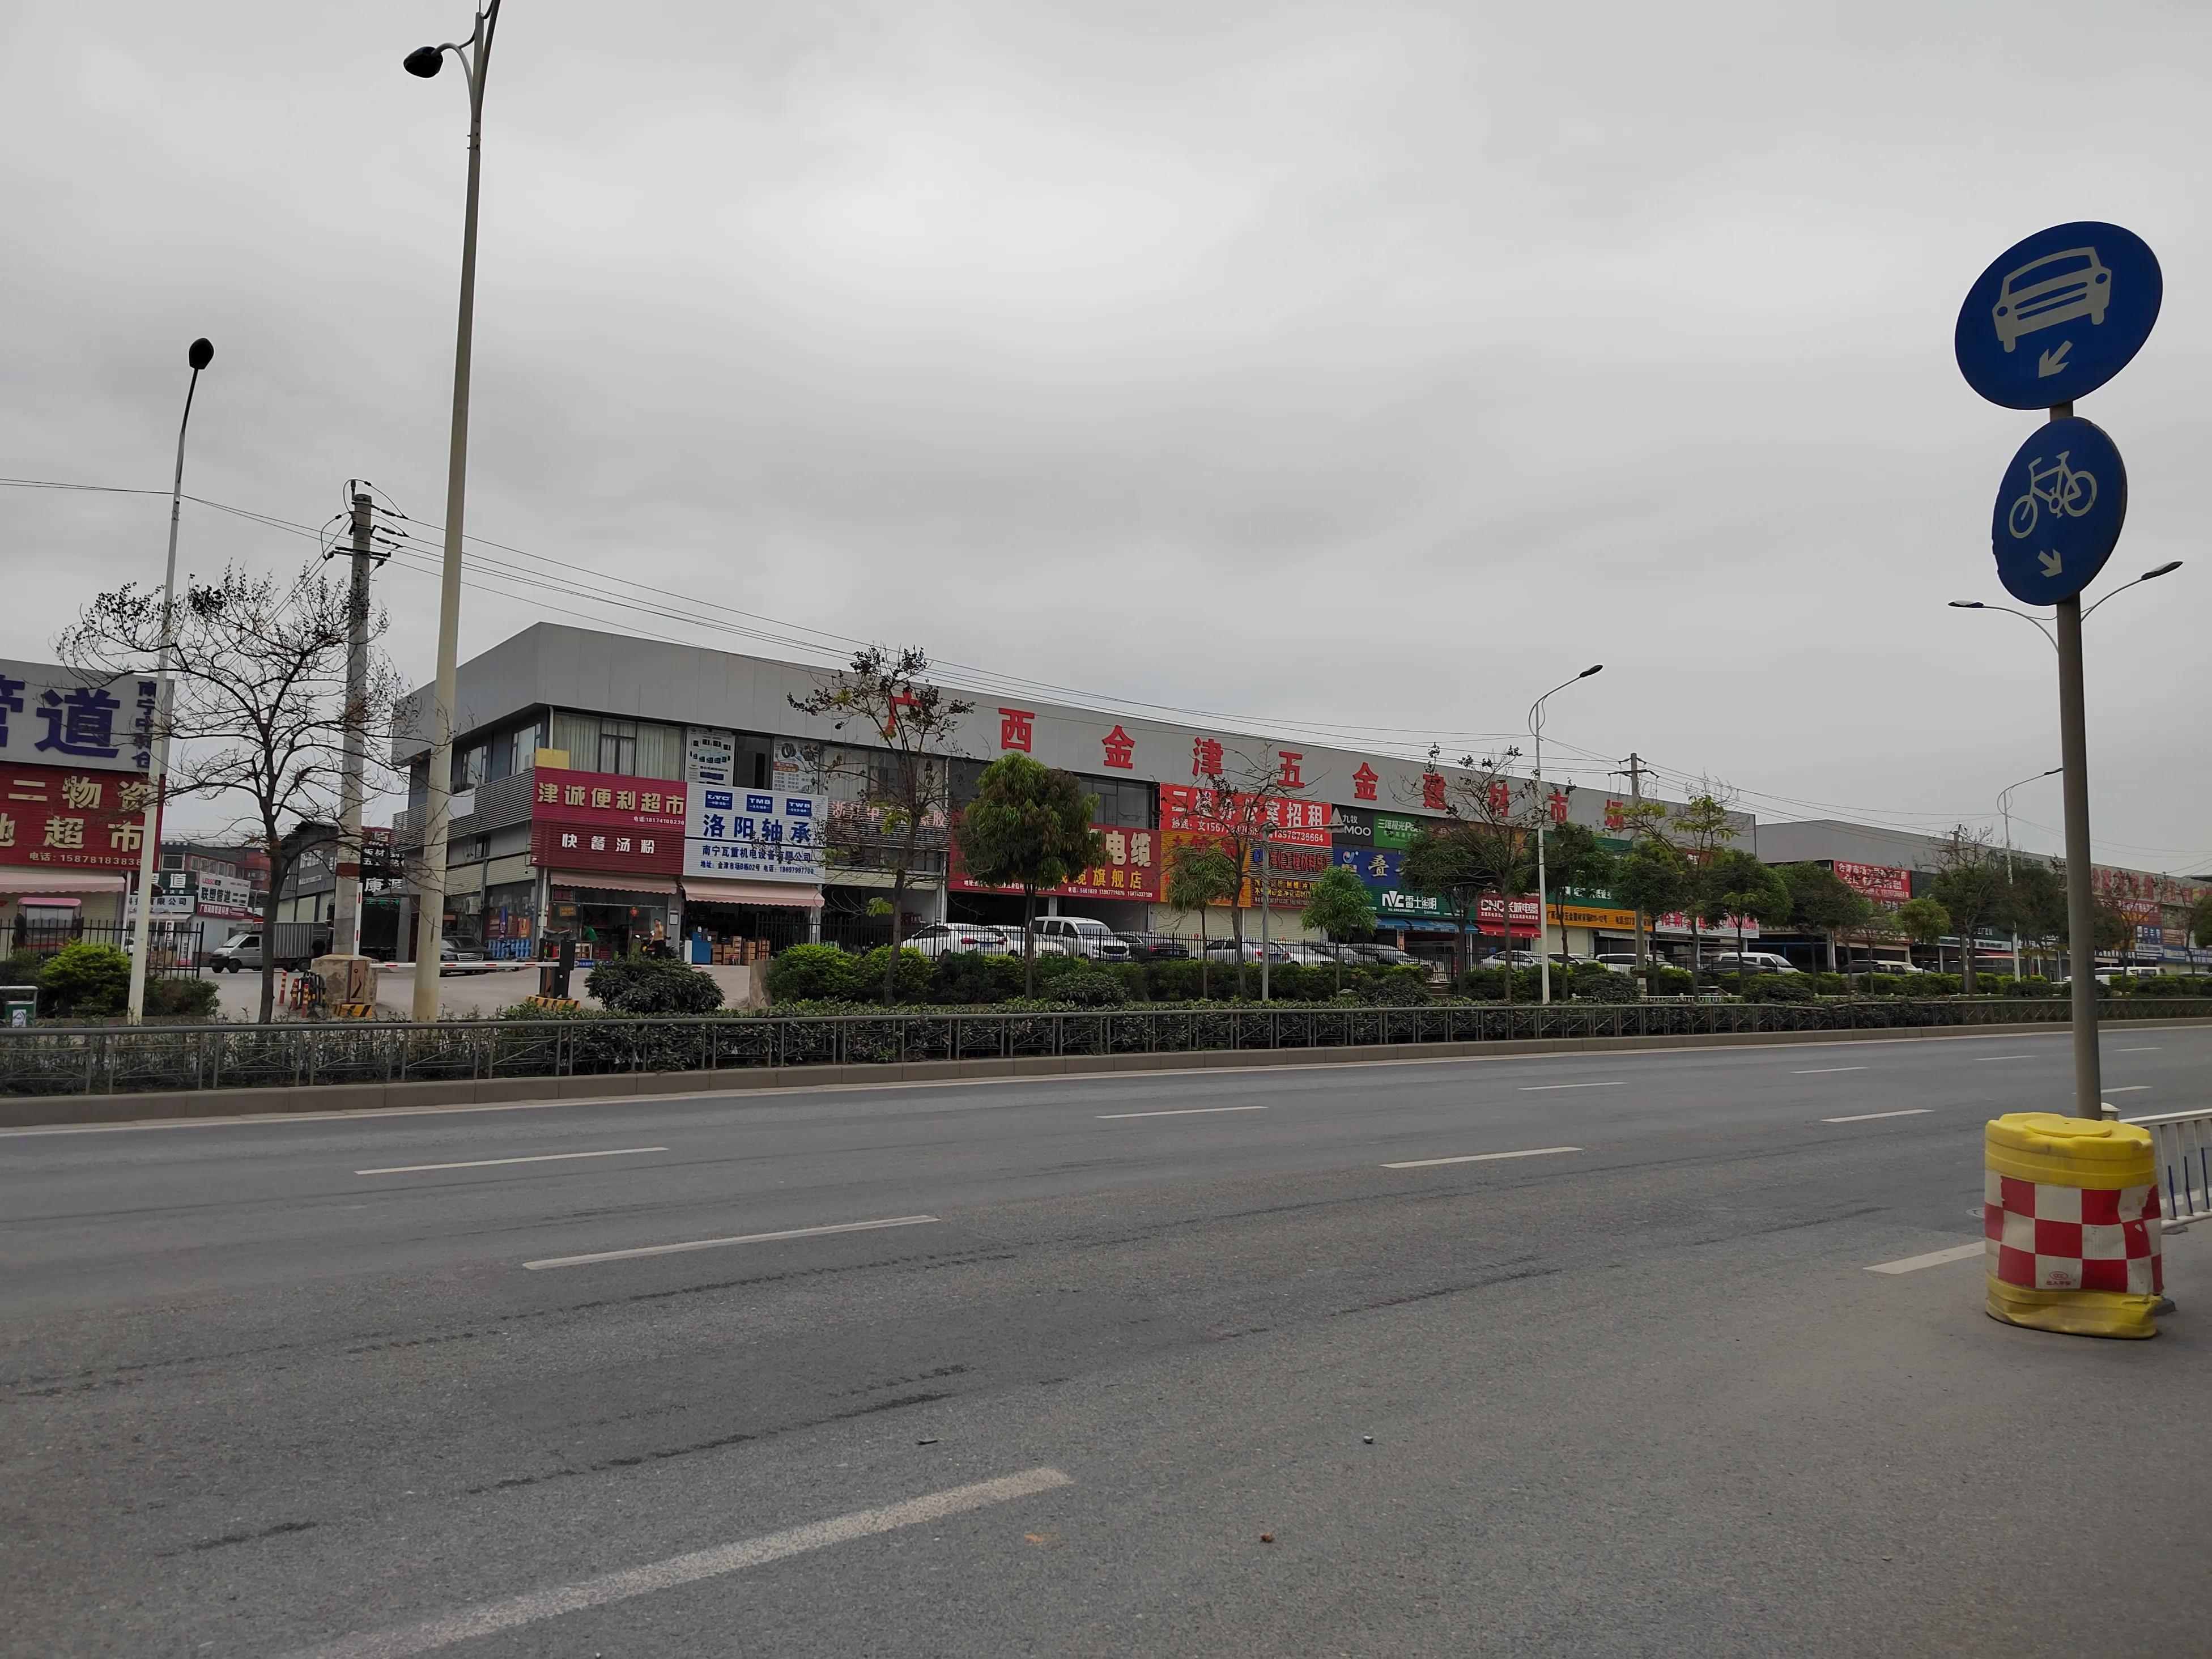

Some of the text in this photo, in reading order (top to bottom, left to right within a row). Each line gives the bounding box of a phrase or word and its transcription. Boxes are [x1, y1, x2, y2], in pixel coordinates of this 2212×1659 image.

[538, 782, 684, 815] 津诚便利超市
[1342, 814, 1358, 824] 九牧
[703, 814, 811, 844] 洛阳轴承
[1344, 825, 1371, 836] MOO
[561, 833, 655, 854] 快餐汤粉
[1382, 891, 1404, 907] NVC
[1405, 895, 1437, 910] 雷士照明
[1481, 899, 1504, 912] CNC
[1508, 901, 1538, 914] 长城电器
